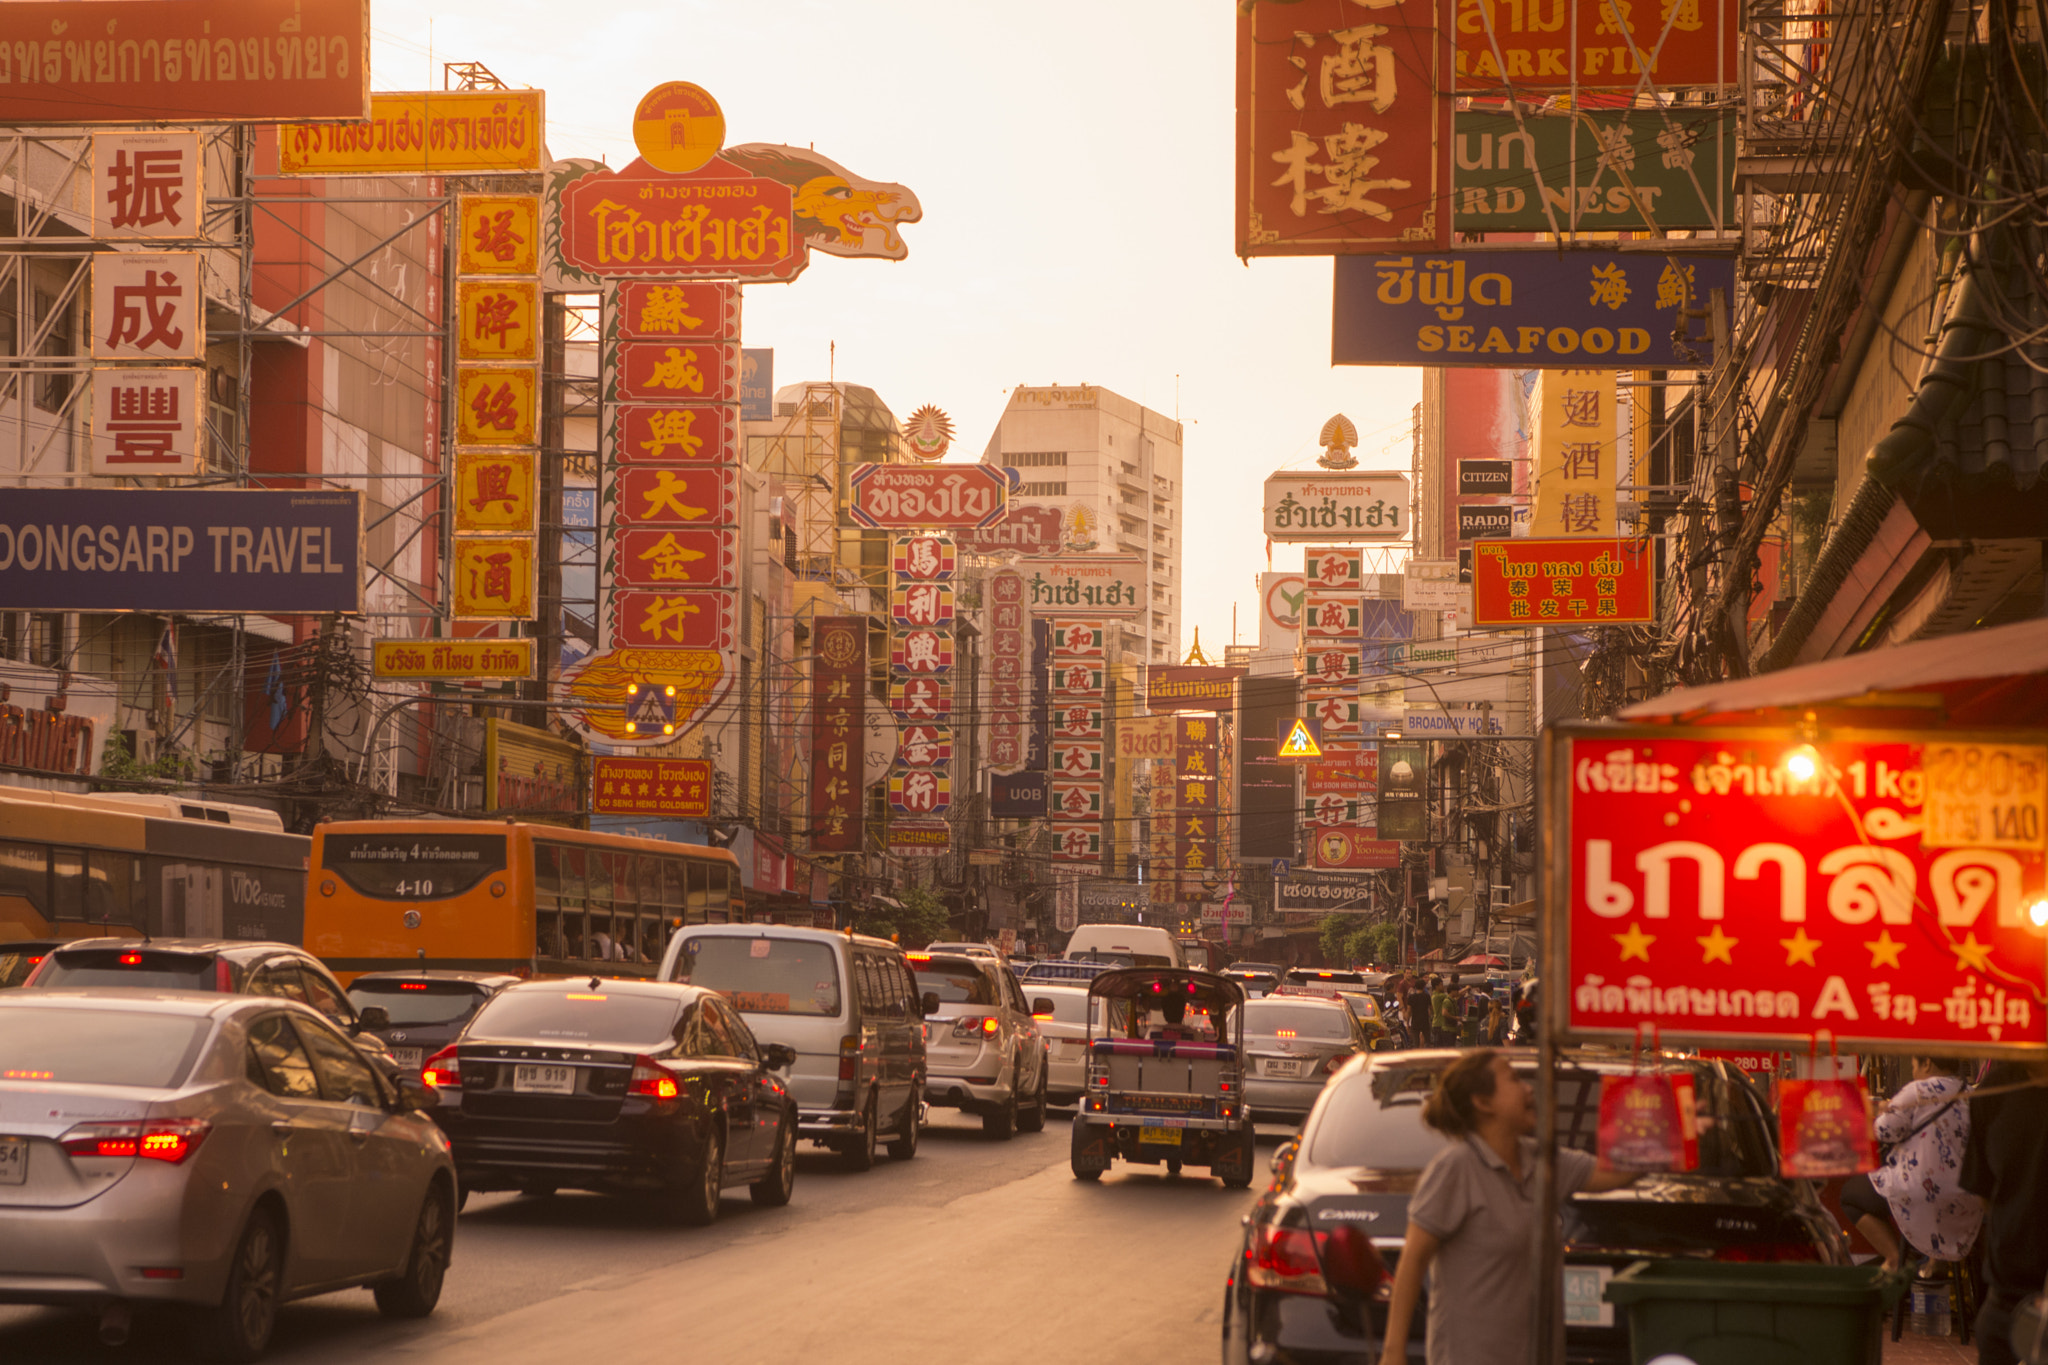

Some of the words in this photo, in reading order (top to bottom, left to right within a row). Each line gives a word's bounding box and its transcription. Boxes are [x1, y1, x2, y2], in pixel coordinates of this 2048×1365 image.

[1583, 47, 1658, 75] FIN
[639, 183, 757, 199] ห้างขายทอง
[1455, 186, 1525, 214] RD
[1541, 186, 1662, 214] NEST
[105, 149, 183, 464] 振成豐
[1417, 326, 1651, 354] SEAFOOD
[1560, 370, 1602, 532] 翅酒樓
[873, 469, 934, 486] ห้างทอง
[1462, 472, 1508, 482] CITIZEN
[868, 474, 991, 517] ทองใบ
[1301, 484, 1371, 496] ห้างขายทอง
[1463, 516, 1509, 526] RADO
[207, 526, 343, 573] TRAVEL
[1050, 564, 1112, 577] ห้างขายทอง
[1498, 556, 1537, 577] ไทย
[1543, 562, 1582, 577] หลง
[1511, 600, 1617, 617] 批发干果
[385, 648, 425, 671] บริษัท
[1409, 716, 1465, 730] BROADWAY
[1469, 717, 1501, 730] HOEL
[826, 674, 850, 836] 北京同仁堂
[1010, 788, 1042, 800] UOB
[599, 799, 610, 807] SO
[613, 799, 633, 808] SENG
[636, 800, 657, 809] HENG
[660, 801, 704, 810] GOLDSMITH
[889, 831, 949, 843] EXCHANGE
[410, 844, 419, 859] 4
[1585, 807, 2023, 927] เกาลัด
[395, 880, 433, 895] 4-10
[1811, 976, 1859, 1020] A
[545, 1068, 569, 1081] 919
